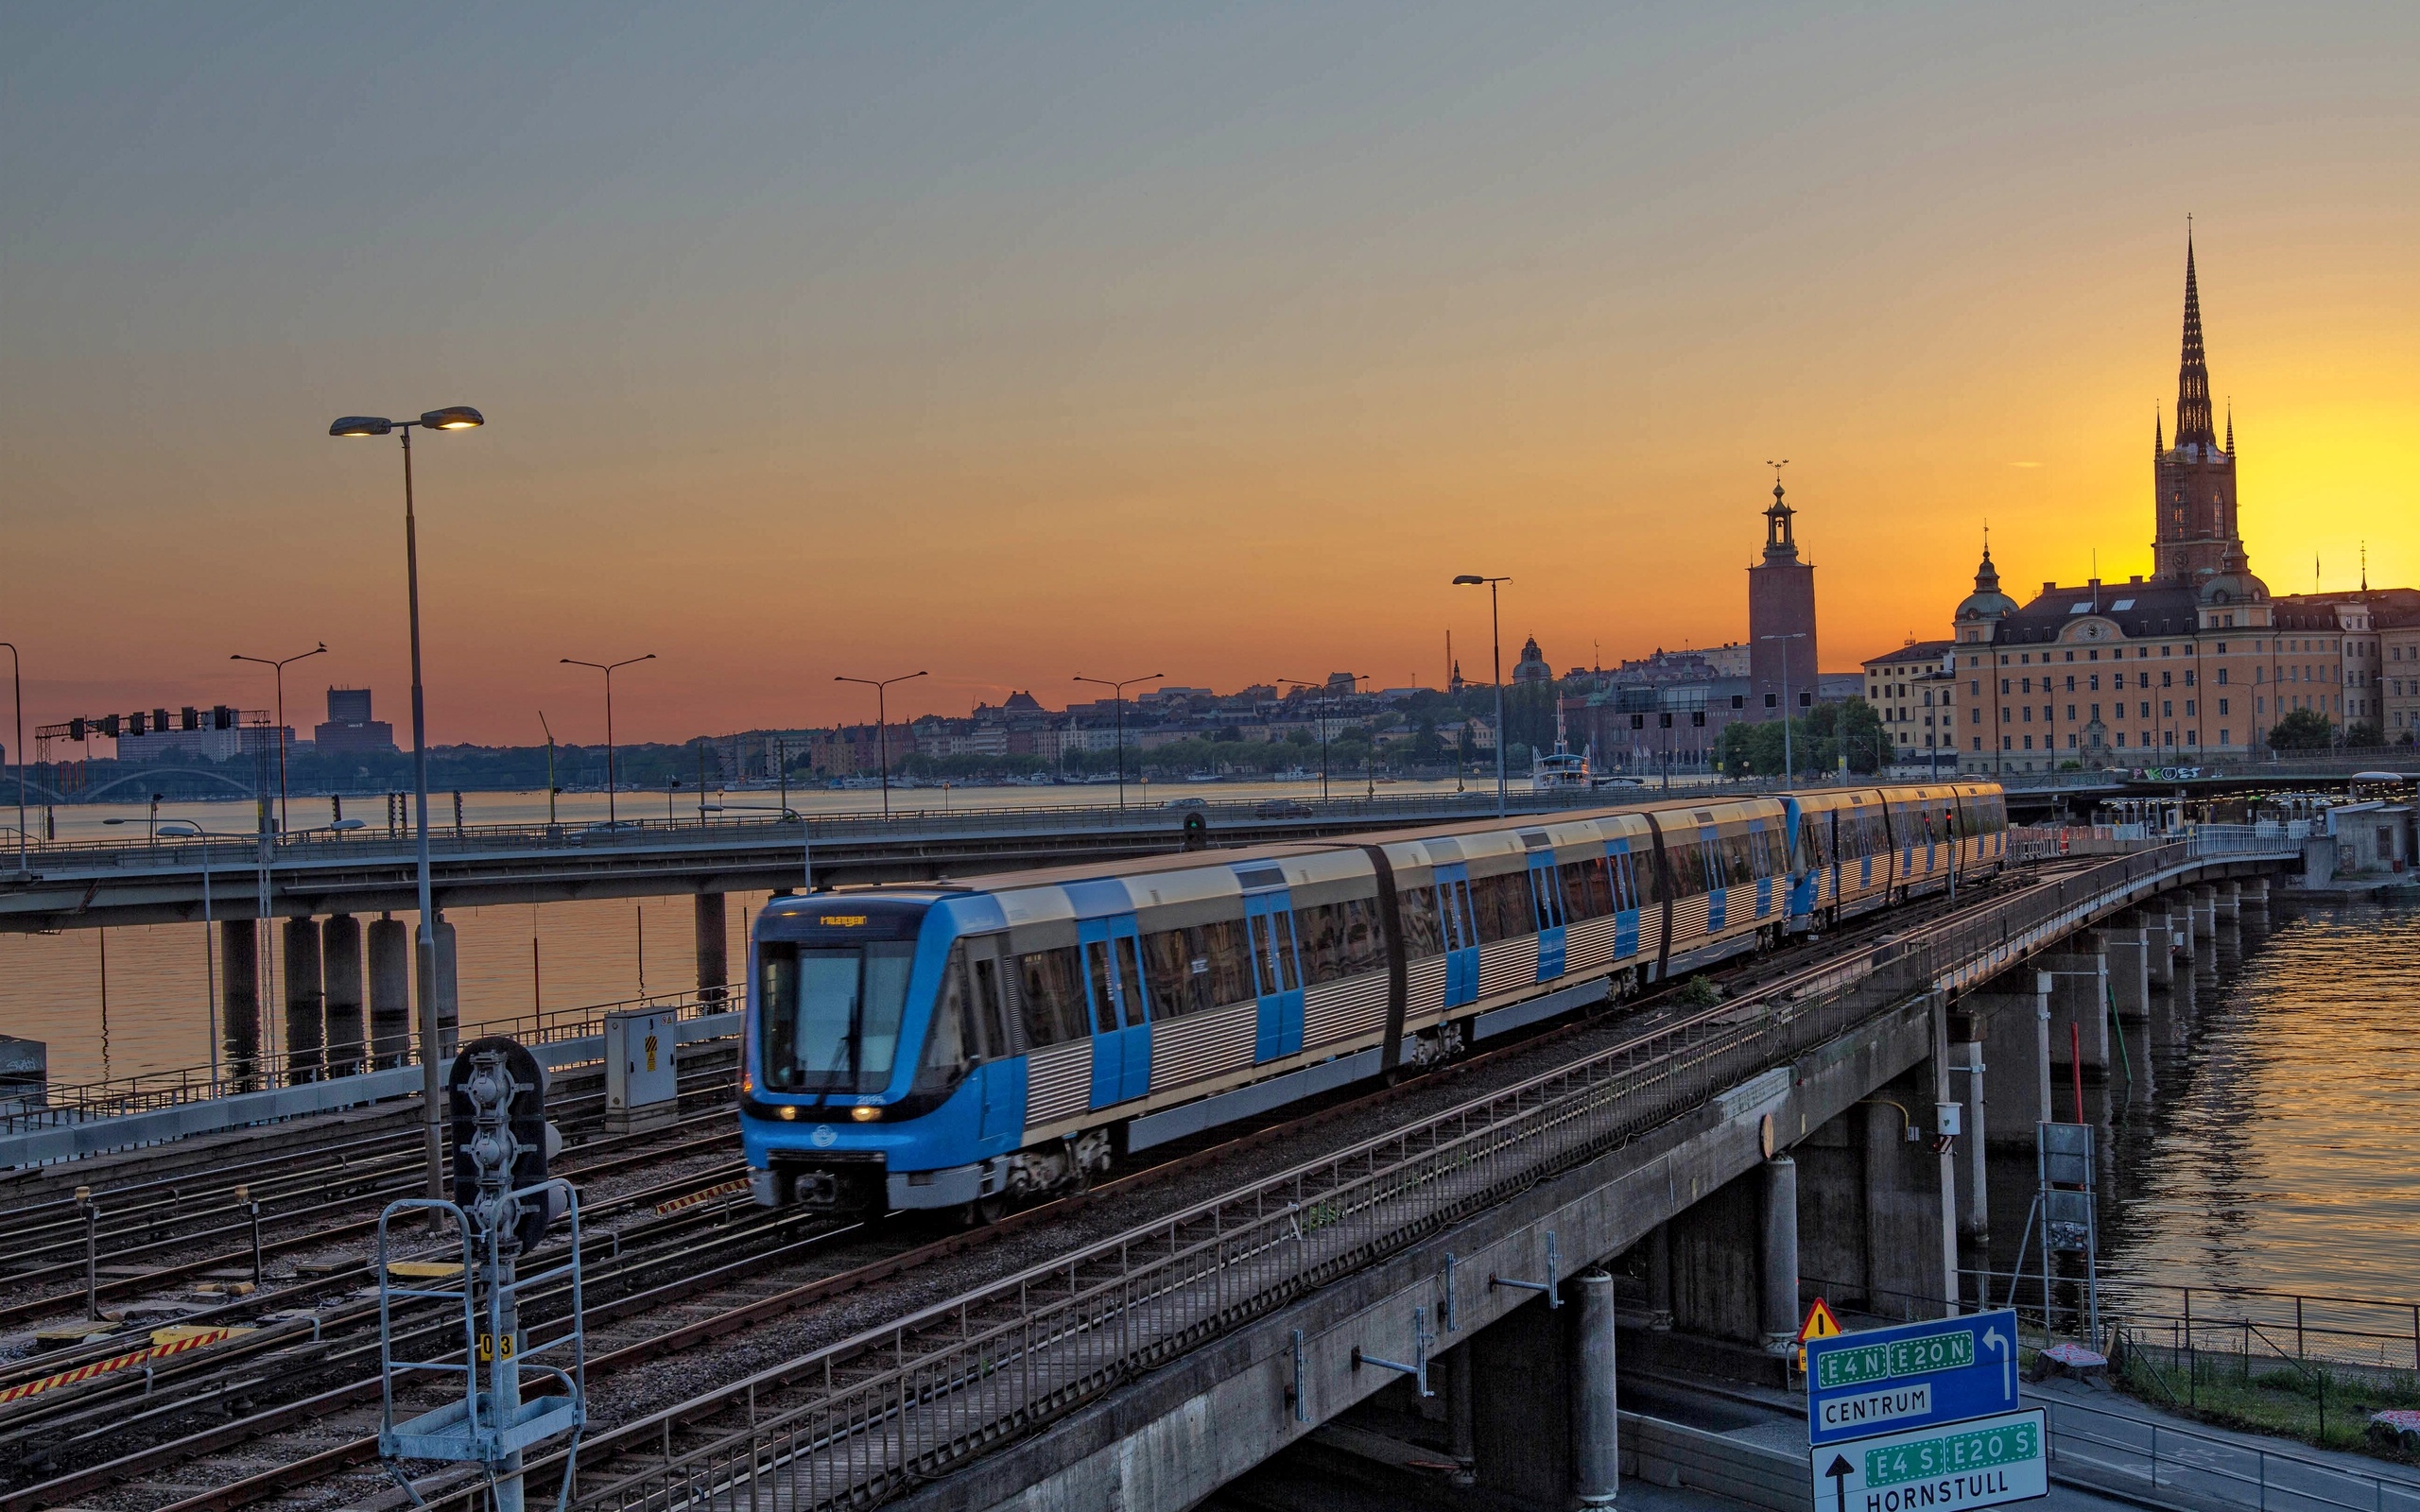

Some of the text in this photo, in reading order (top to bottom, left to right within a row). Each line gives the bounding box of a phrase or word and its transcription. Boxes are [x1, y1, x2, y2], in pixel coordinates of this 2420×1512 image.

[1898, 1343, 1944, 1368] E20
[1825, 1390, 1925, 1424] CENTRUM
[1877, 1431, 2029, 1478] E4 S E20 S
[1867, 1470, 2009, 1512] HORNSTULL
